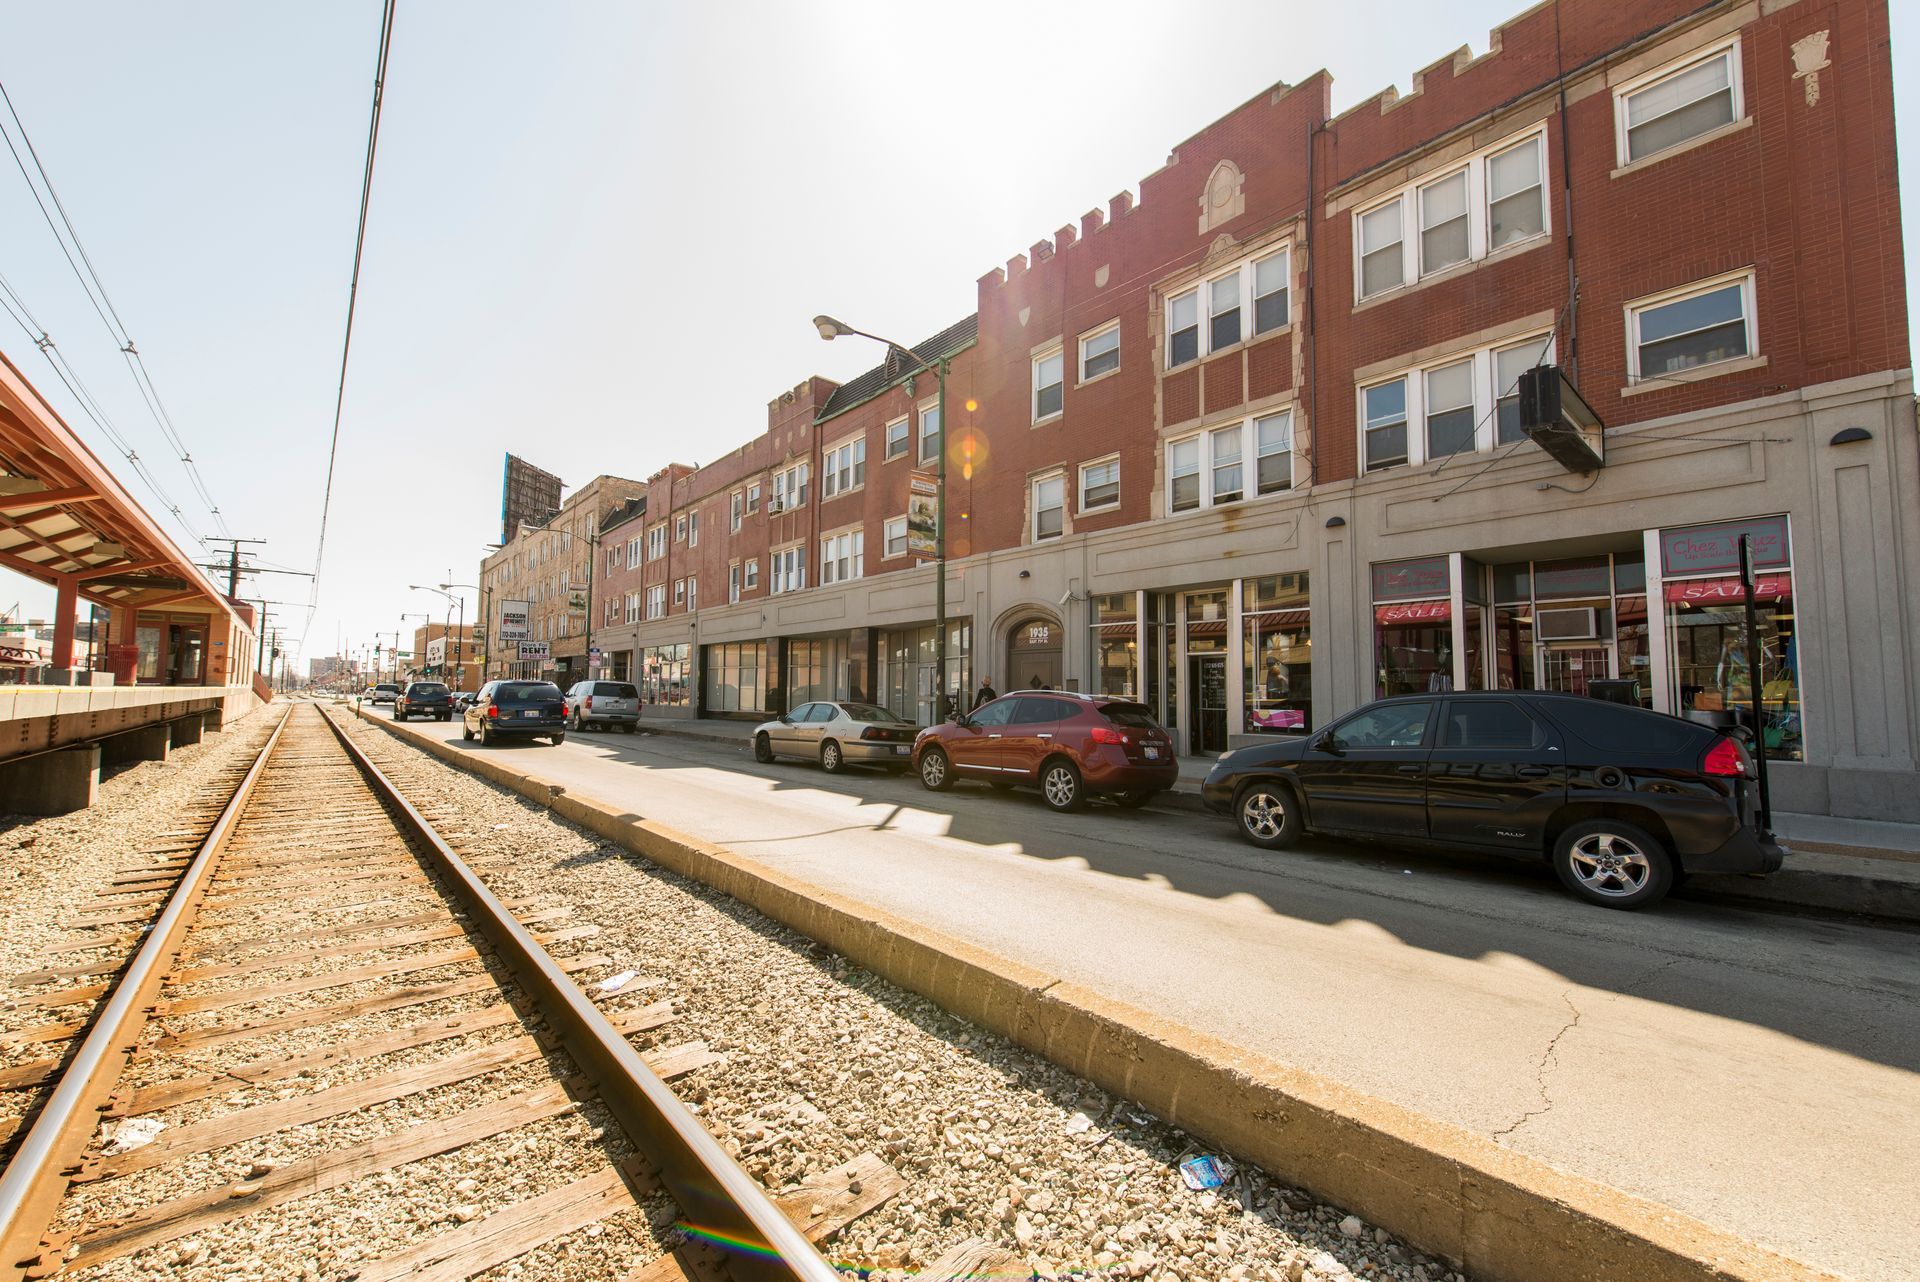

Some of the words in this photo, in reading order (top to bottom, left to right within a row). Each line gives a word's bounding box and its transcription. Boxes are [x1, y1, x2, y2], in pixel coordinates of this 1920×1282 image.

[1673, 538, 1718, 555] Chez
[1729, 534, 1777, 547] Vuz
[1682, 583, 1778, 599] SALE
[1386, 608, 1444, 619] SALE
[1030, 627, 1049, 637] 1935
